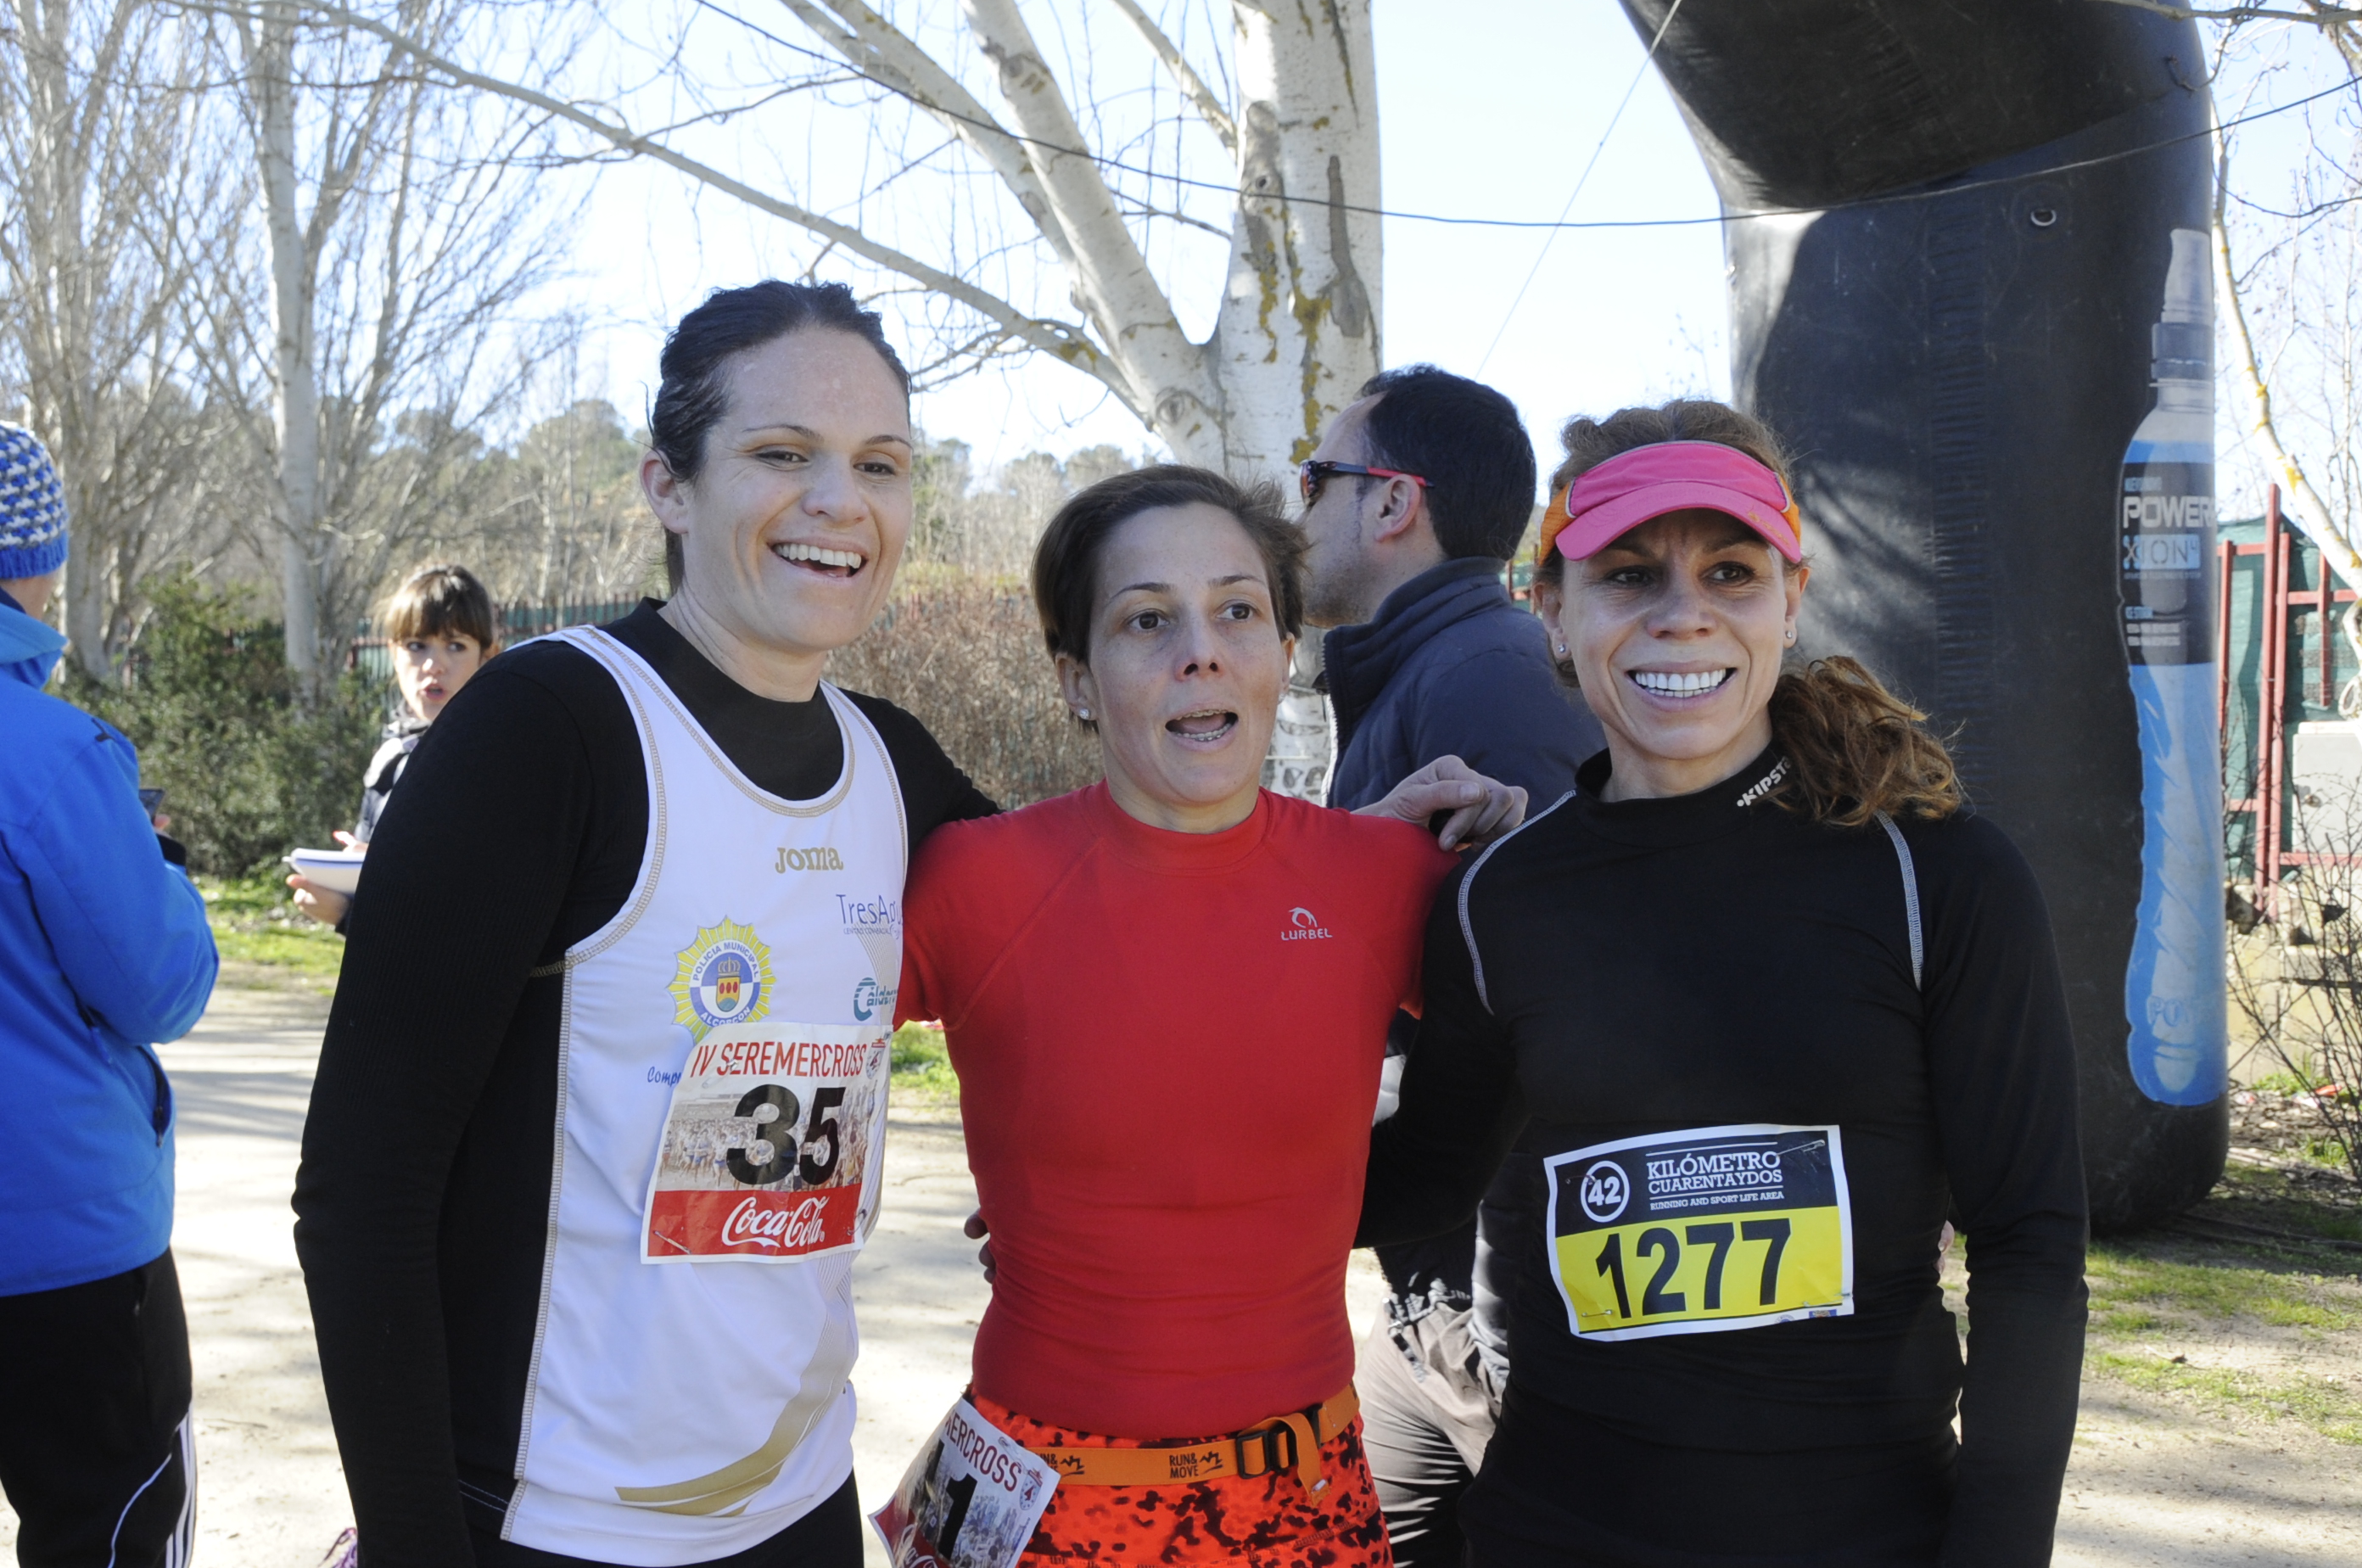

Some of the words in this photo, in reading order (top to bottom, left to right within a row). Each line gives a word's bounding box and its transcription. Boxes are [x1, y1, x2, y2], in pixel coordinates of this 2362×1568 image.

[1281, 928, 1333, 941] LURBEL
[692, 945, 722, 981] POLICIA
[724, 942, 759, 977] MUNICIPAL
[690, 1044, 717, 1078] IV
[717, 1042, 867, 1077] SEREMERCROSS
[726, 1084, 847, 1185] 35
[1646, 1151, 1781, 1179] KILÓMETRO
[1587, 1176, 1621, 1206] 42
[1648, 1169, 1783, 1195] CUARENTAYDOS
[1650, 1199, 1688, 1211] RUNNING
[1689, 1196, 1710, 1207] AND
[1710, 1195, 1739, 1205] SPORT
[1739, 1192, 1759, 1202] LIFE
[1760, 1190, 1784, 1201] AREA
[1595, 1218, 1792, 1319] 1277
[1170, 1464, 1200, 1479] MOVE
